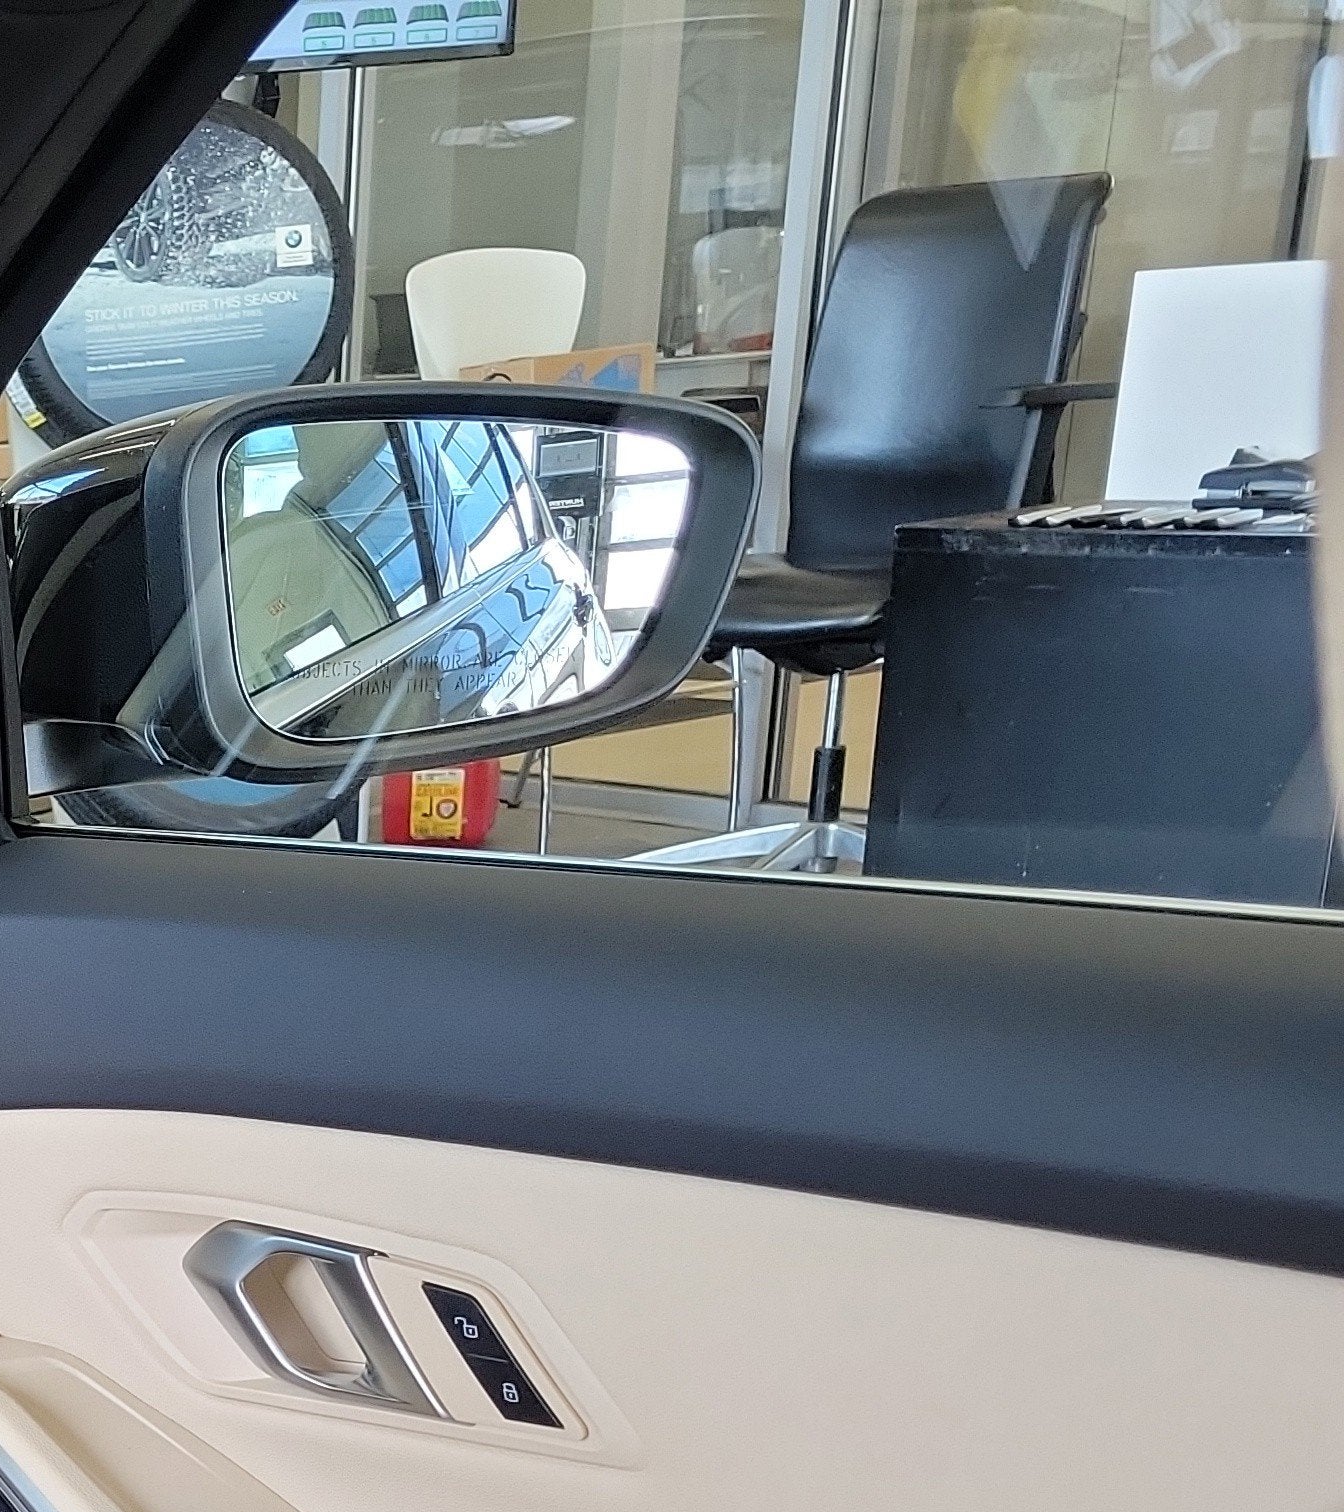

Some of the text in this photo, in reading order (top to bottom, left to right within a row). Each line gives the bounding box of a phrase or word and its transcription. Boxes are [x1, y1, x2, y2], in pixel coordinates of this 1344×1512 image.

[85, 308, 120, 322] STICK
[123, 307, 134, 319] IT
[140, 304, 157, 317] TO
[161, 300, 210, 315] WINTER
[213, 296, 242, 310] THIS
[402, 654, 461, 675] MIRROR
[473, 651, 504, 669] ARE
[350, 671, 518, 697] THAN THEY APPEAR
